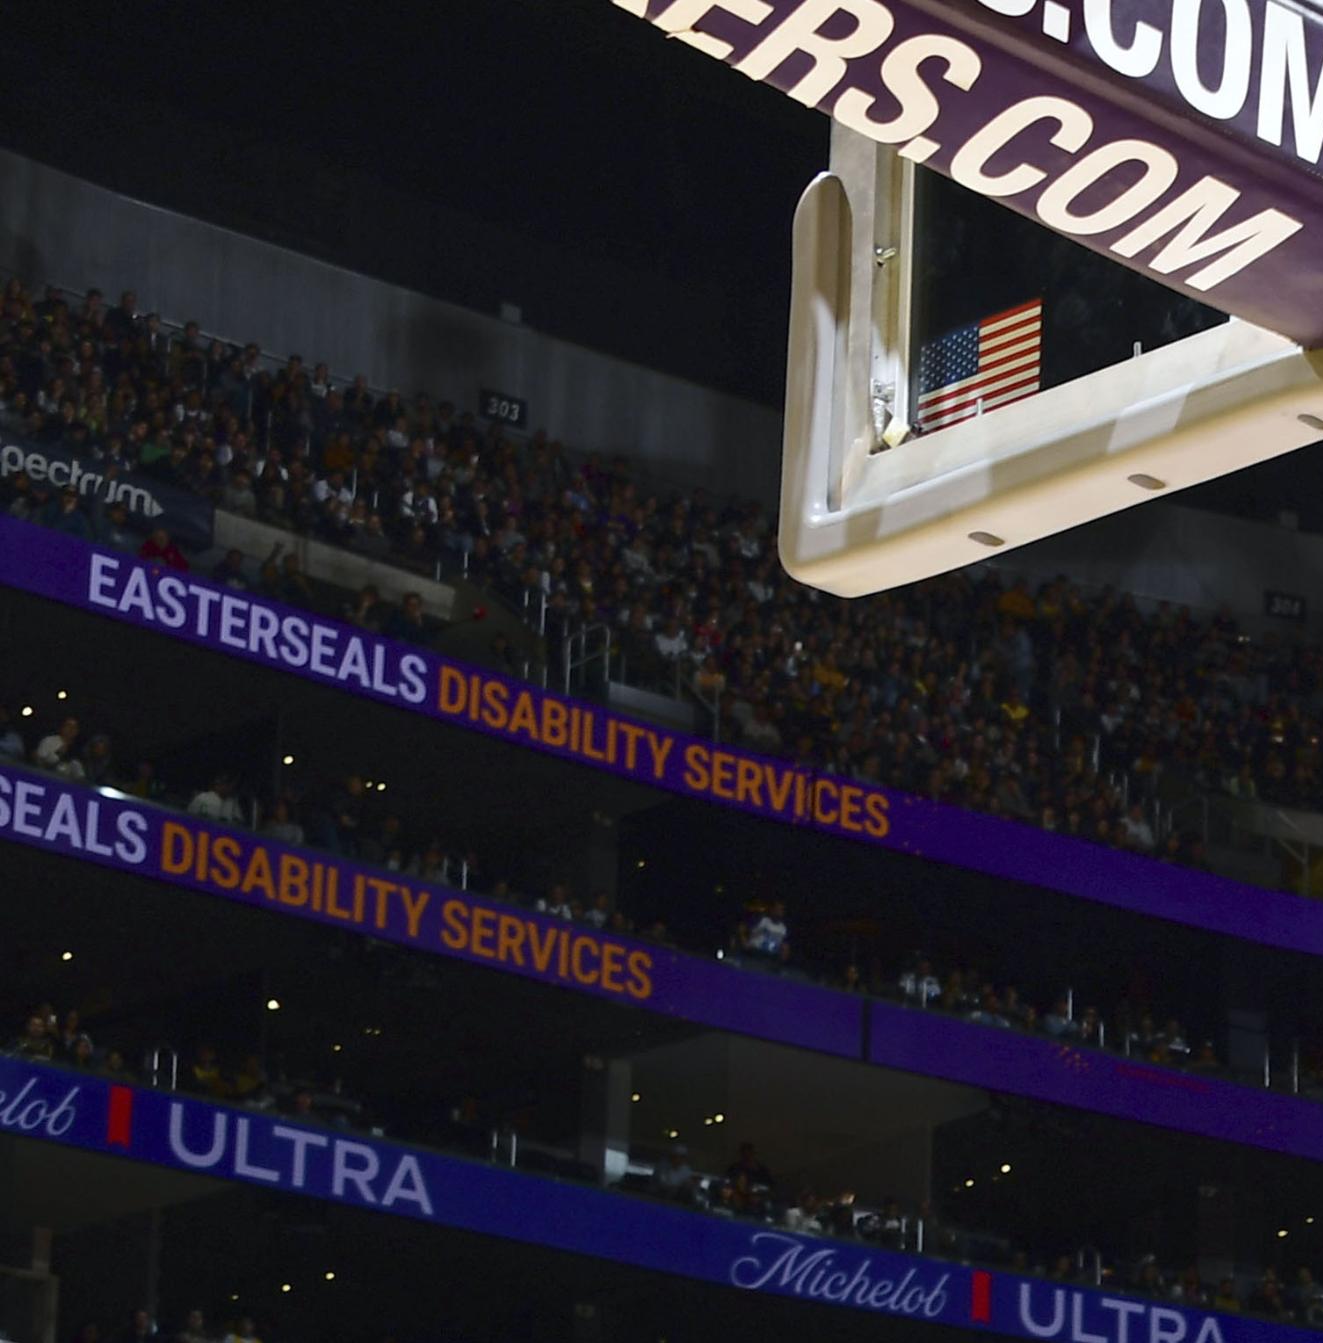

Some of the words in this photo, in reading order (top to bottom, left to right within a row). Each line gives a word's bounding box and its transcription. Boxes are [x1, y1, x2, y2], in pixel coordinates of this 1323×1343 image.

[88, 552, 430, 705] EASTERSEALS
[436, 664, 675, 780] DISABILITY
[682, 743, 892, 839] SERVICES
[160, 821, 430, 937] DISABILITY
[439, 900, 654, 999] SERVICES
[168, 1102, 434, 1216] ULTRA
[730, 1230, 951, 1320] Michelob
